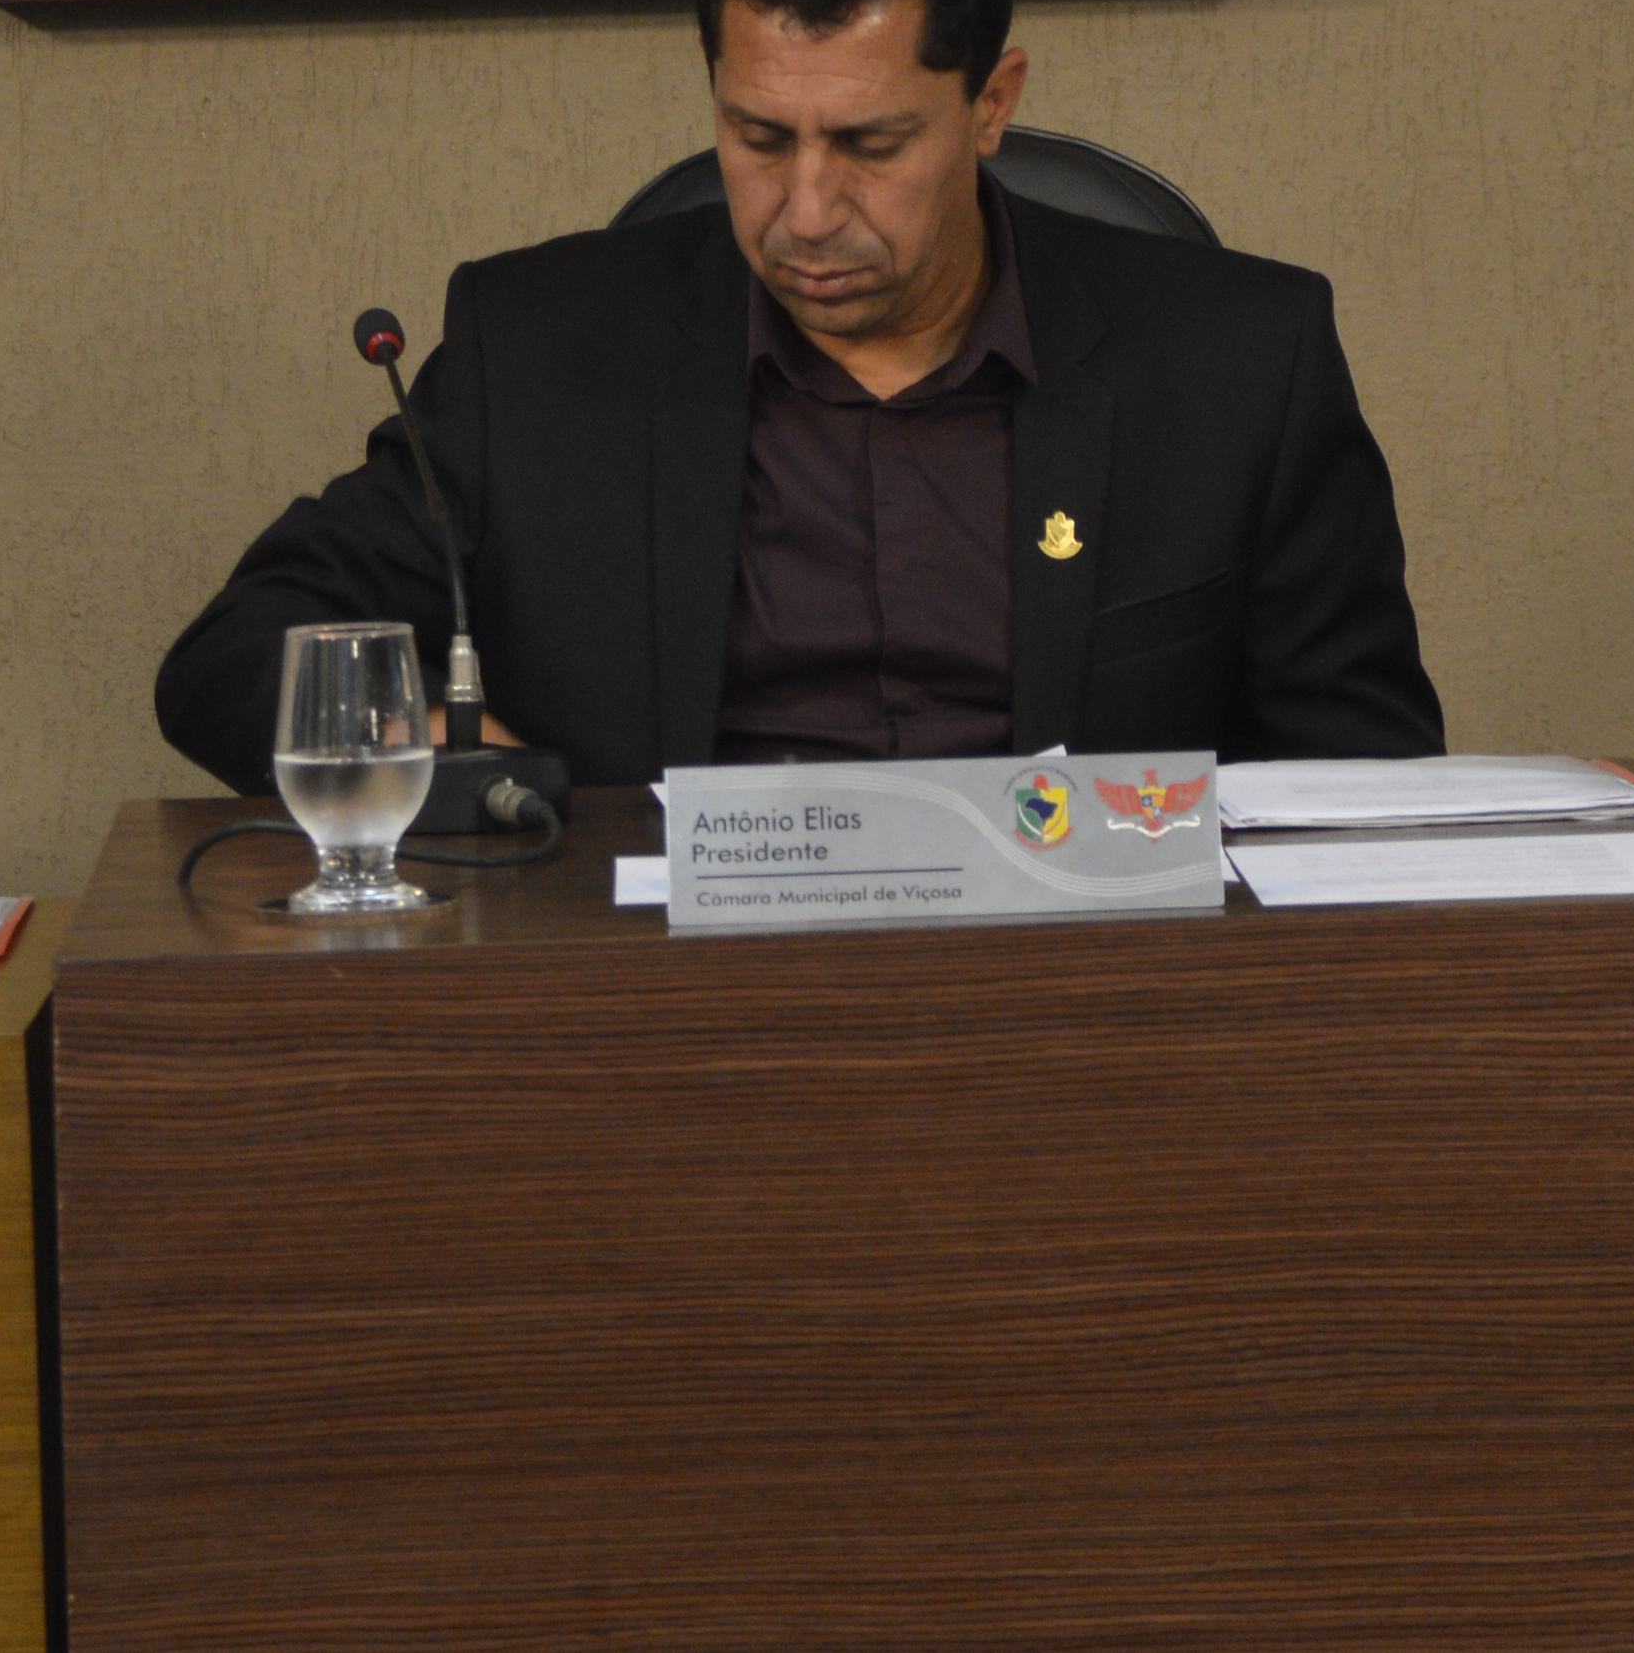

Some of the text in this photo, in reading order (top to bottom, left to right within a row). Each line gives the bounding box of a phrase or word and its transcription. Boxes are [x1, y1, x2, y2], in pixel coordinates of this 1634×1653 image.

[693, 806, 862, 834] Antônio Elias
[692, 841, 828, 864] Presidente
[697, 886, 962, 907] Câmara Municipal de Viçosa
